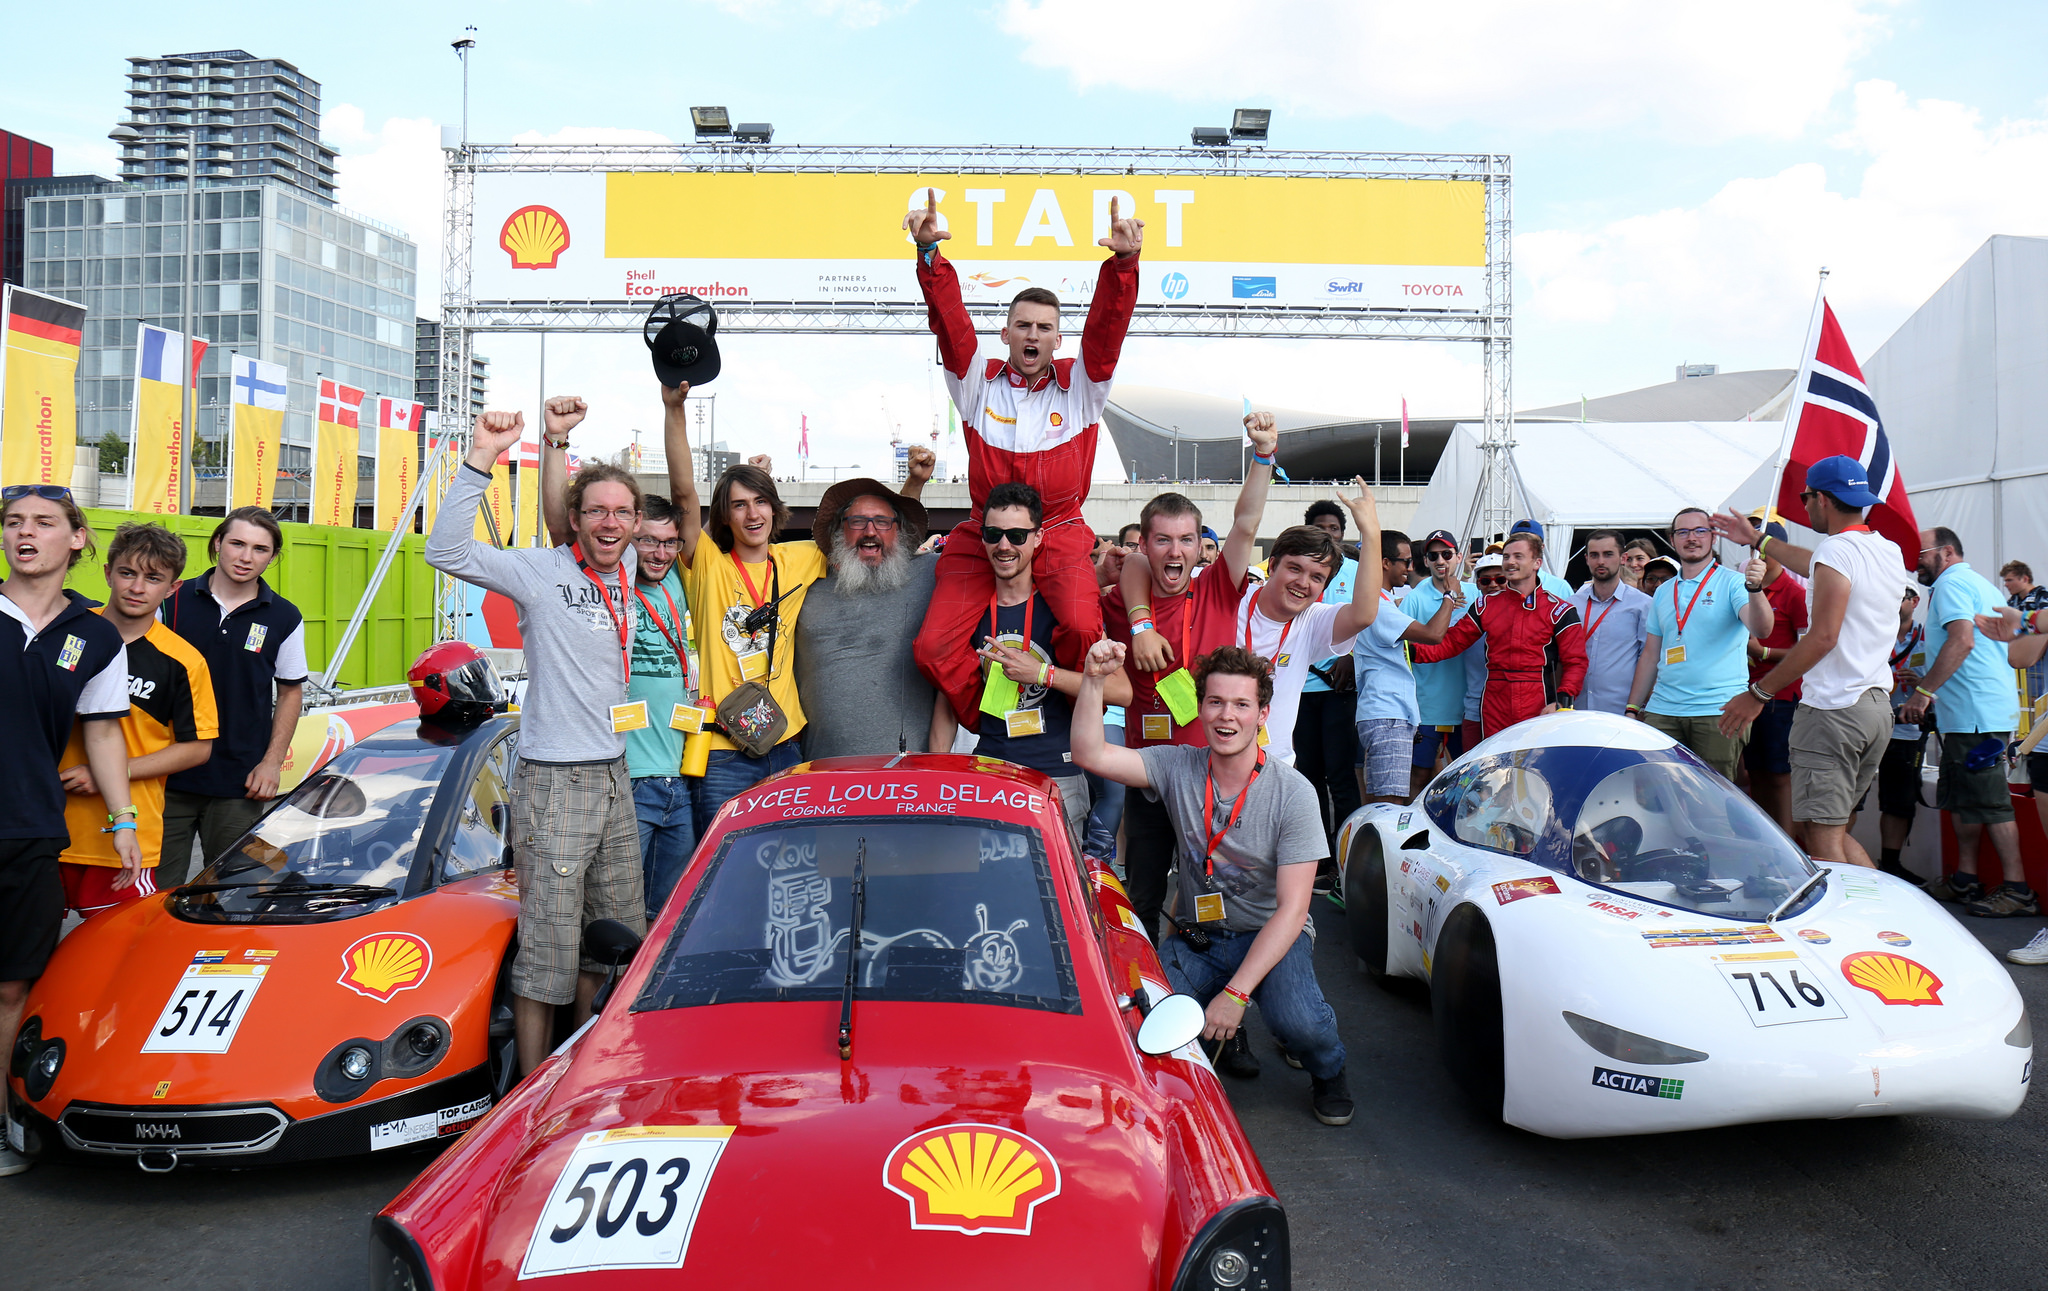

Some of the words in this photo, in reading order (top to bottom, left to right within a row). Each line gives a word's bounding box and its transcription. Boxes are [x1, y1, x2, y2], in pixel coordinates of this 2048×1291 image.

[626, 270, 656, 281] Shell
[625, 282, 749, 297] Eco-marathon
[1163, 272, 1188, 300] hp
[1327, 281, 1363, 293] SwRI
[1401, 284, 1464, 296] TOYOTA
[731, 786, 811, 818] LYCEE
[828, 784, 919, 802] LOUIS
[939, 783, 1043, 815] DELAGE
[783, 804, 847, 818] COGNAC
[896, 802, 957, 814] FRANCE
[1587, 901, 1640, 919] INSA
[1731, 969, 1825, 1012] 716
[160, 989, 245, 1037] 514
[440, 1108, 460, 1120] TOP
[372, 1120, 407, 1138] TEMA
[403, 1120, 436, 1137] SINERGIE
[549, 1157, 691, 1244] 503
